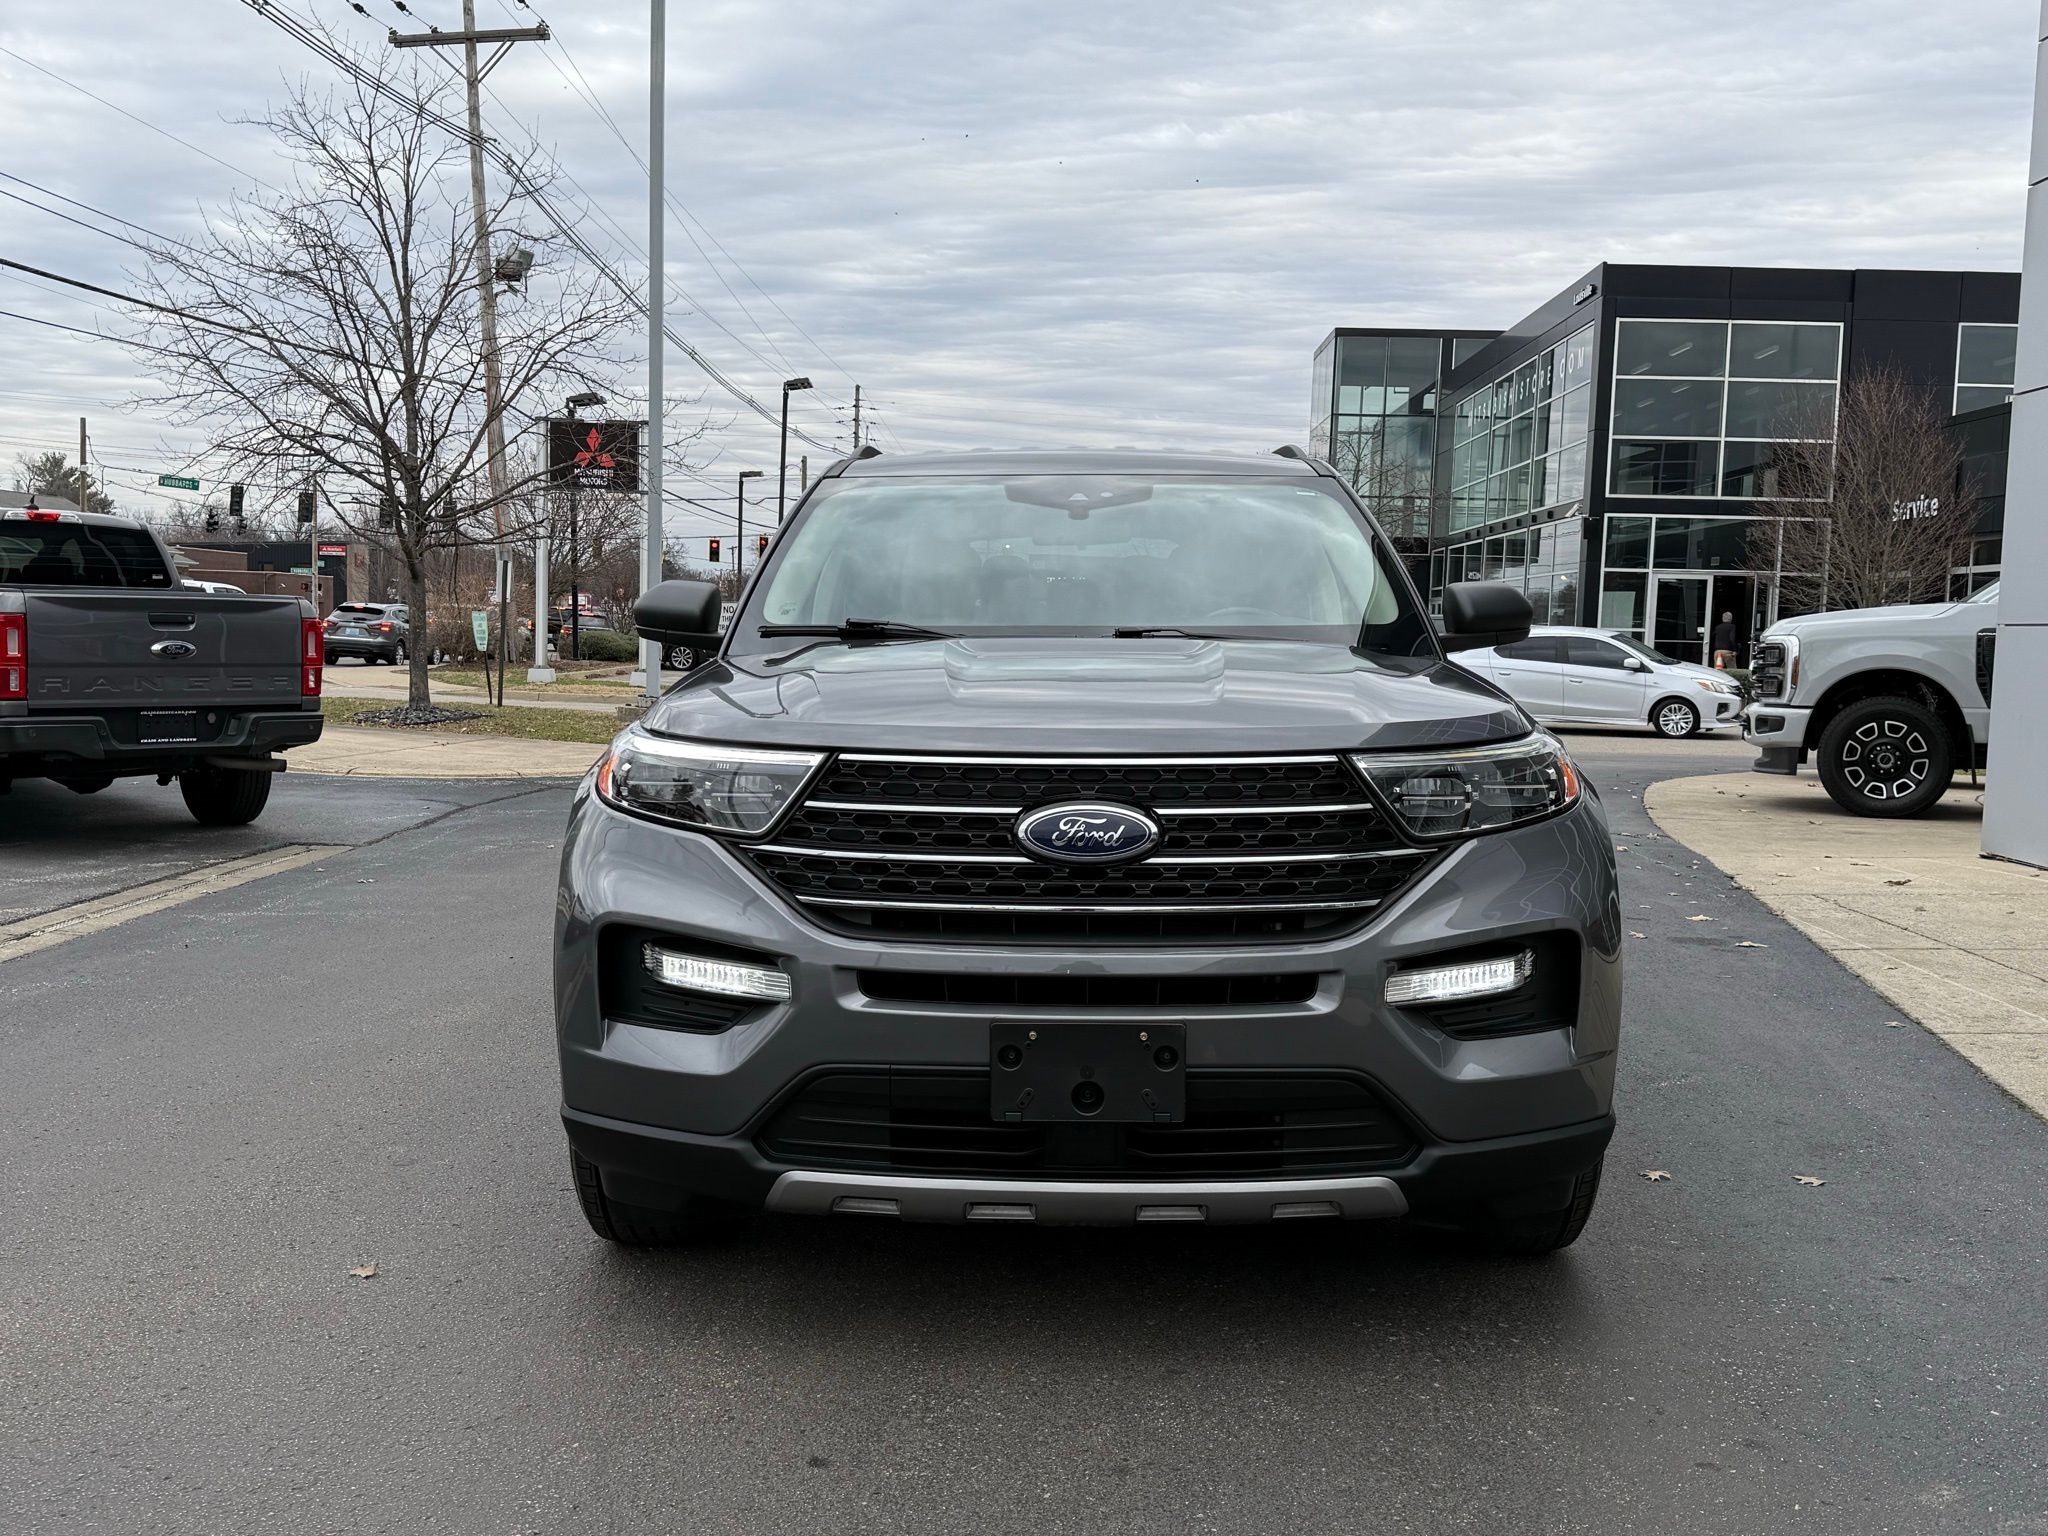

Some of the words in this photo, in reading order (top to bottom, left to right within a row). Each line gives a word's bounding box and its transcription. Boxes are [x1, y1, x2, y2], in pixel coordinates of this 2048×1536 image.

[1892, 494, 1939, 521] Service
[723, 605, 735, 614] NO
[166, 644, 187, 654] Ford
[38, 676, 294, 693] RANGER
[1051, 816, 1126, 847] Ford
